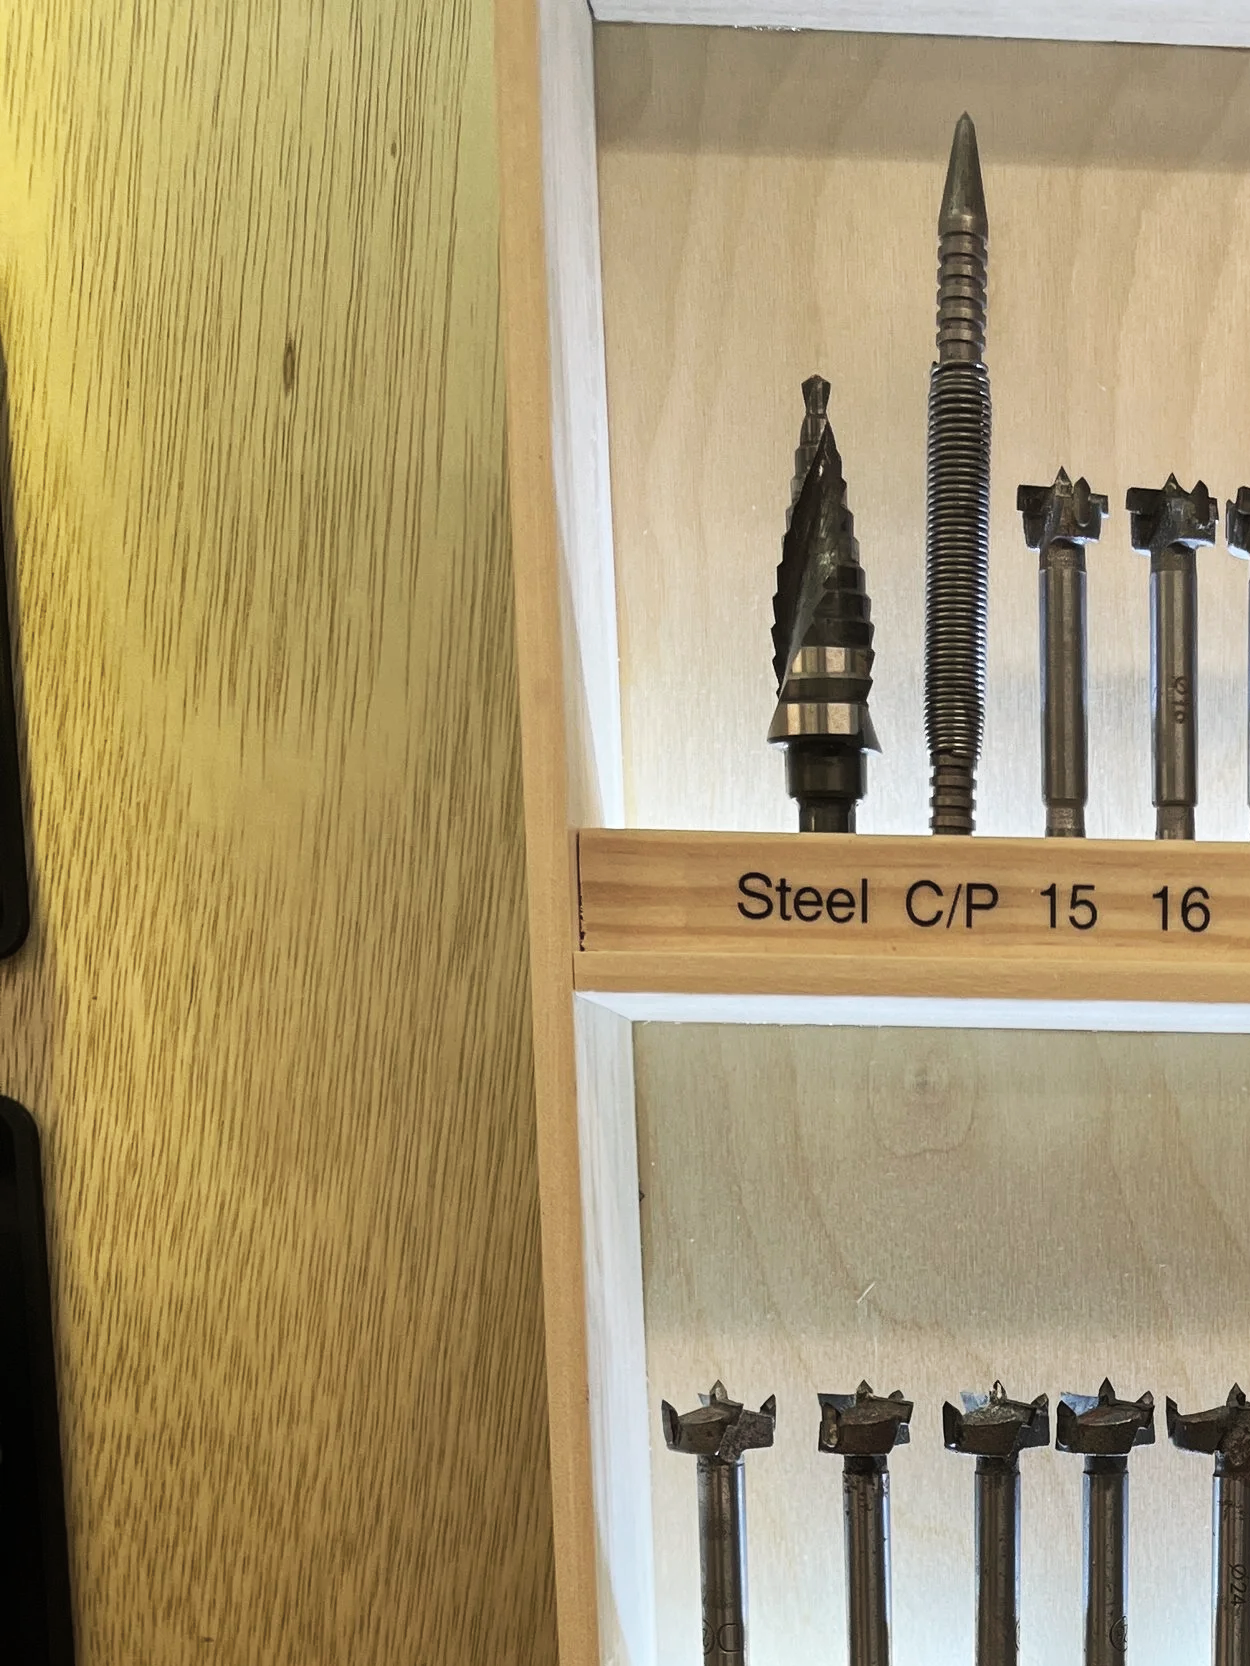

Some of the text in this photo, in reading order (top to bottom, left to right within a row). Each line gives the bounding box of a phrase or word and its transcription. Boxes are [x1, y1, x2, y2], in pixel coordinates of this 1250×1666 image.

[738, 872, 868, 924] Steel
[906, 880, 1000, 929] C/P
[1040, 883, 1098, 931] 15
[1152, 886, 1211, 933] 16
